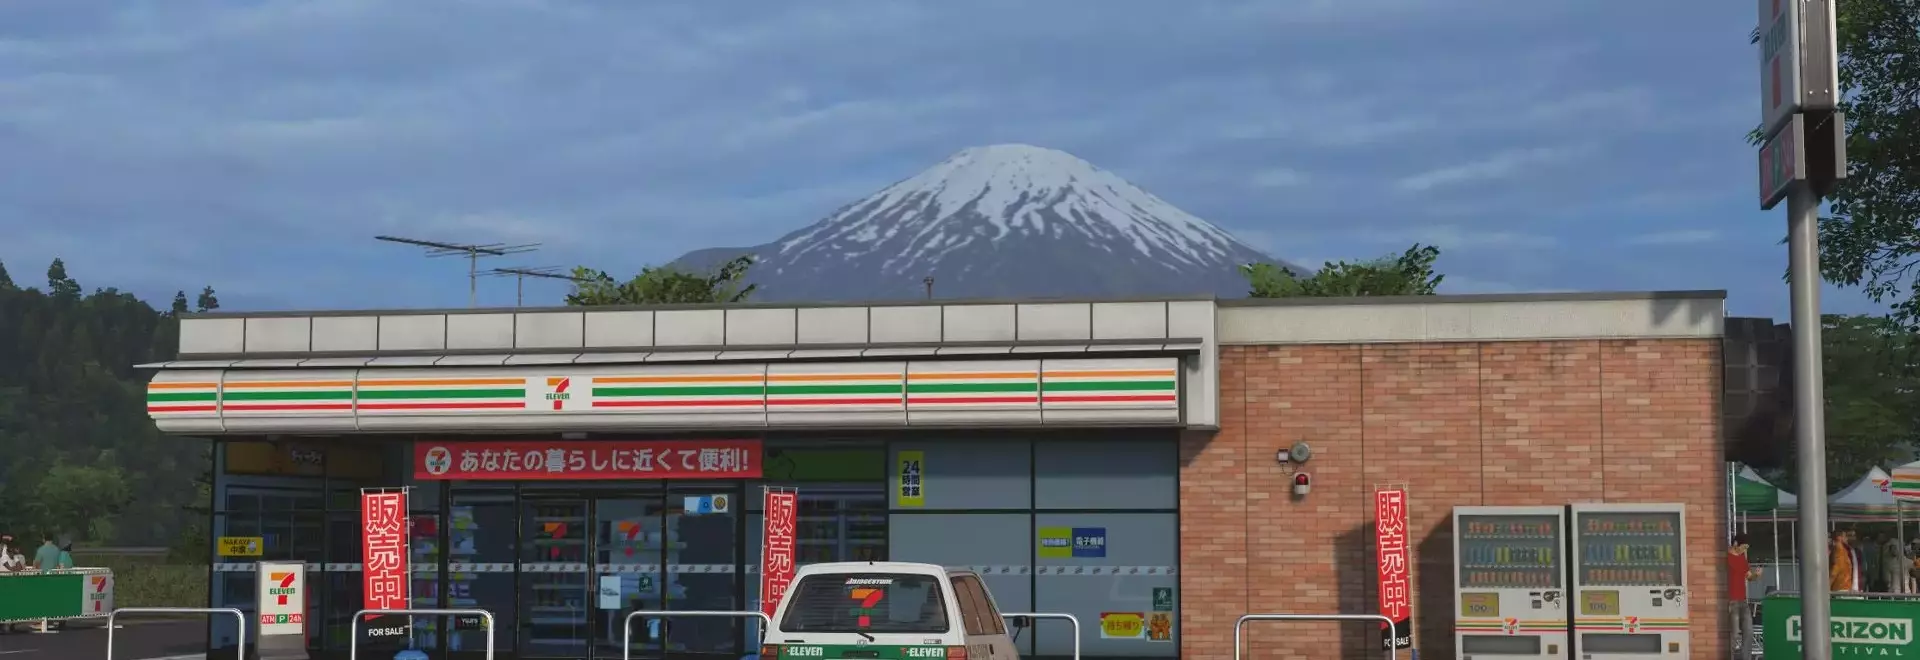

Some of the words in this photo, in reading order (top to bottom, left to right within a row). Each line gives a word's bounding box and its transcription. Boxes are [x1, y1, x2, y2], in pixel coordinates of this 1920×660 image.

[460, 448, 748, 472] あなたの暮らしに近くて便利!
[903, 460, 920, 474] 24
[902, 475, 920, 485] 時間
[366, 494, 400, 609] 販売中
[768, 493, 793, 610] 販売中
[1378, 491, 1406, 617] 販売中
[270, 572, 295, 605] 7
[261, 615, 275, 623] ATM
[368, 628, 384, 637] FOR
[385, 627, 404, 636] SALE
[1396, 636, 1409, 646] SALE
